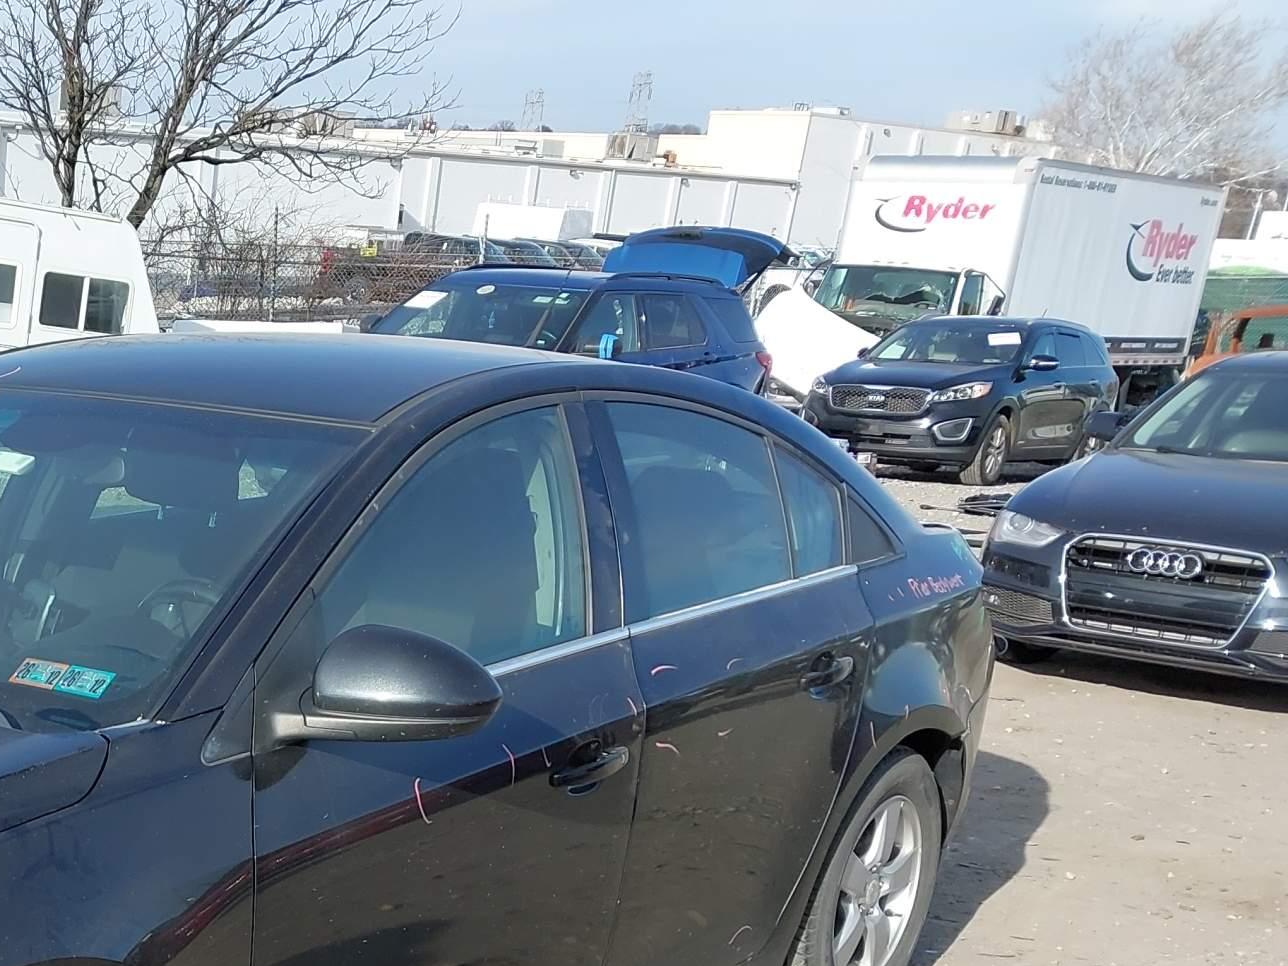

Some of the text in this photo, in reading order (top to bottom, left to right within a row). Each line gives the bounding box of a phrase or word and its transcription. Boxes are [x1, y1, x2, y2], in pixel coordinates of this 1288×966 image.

[903, 195, 996, 224] Ryder
[1142, 219, 1199, 268] Ryder
[1155, 264, 1174, 282] Ever
